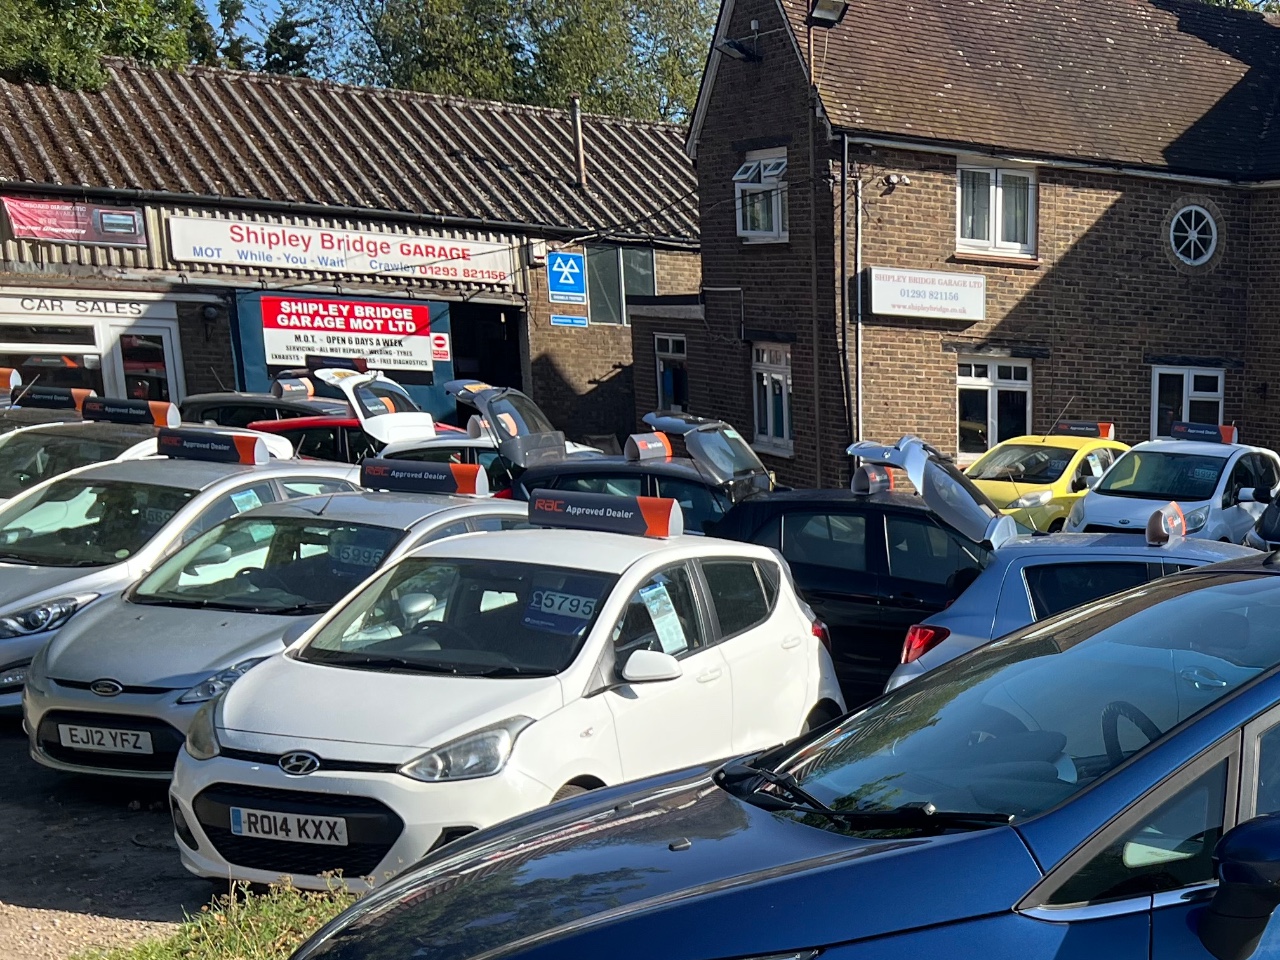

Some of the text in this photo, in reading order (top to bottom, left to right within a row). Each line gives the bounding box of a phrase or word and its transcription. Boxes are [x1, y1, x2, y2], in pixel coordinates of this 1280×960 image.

[229, 224, 471, 261] Shipley Bridge GARAGE
[192, 246, 222, 259] MOT
[237, 249, 273, 262] While
[283, 253, 307, 265] You
[317, 256, 345, 268] Wait
[369, 259, 506, 281] Crawley 01293 821156
[875, 273, 983, 289] SHIPLEY BRIDGE GARAGE LTD
[900, 288, 959, 301] 01293 821156
[20, 297, 142, 315] CAR SALES
[280, 301, 413, 320] SHIPLEY BRIDGE
[276, 314, 416, 333] GARAGE MOT LTD
[326, 335, 346, 344] OPEN
[348, 337, 353, 345] 6
[355, 337, 374, 346] DAYS
[376, 338, 381, 346] A
[382, 338, 404, 347] WEEK
[390, 470, 423, 479] Approved
[423, 472, 447, 480] Dealer
[566, 504, 604, 516] Approved
[606, 508, 634, 519] Dealer
[69, 727, 143, 750] EJ12 YFZ
[247, 813, 341, 842] RO14 KXX
